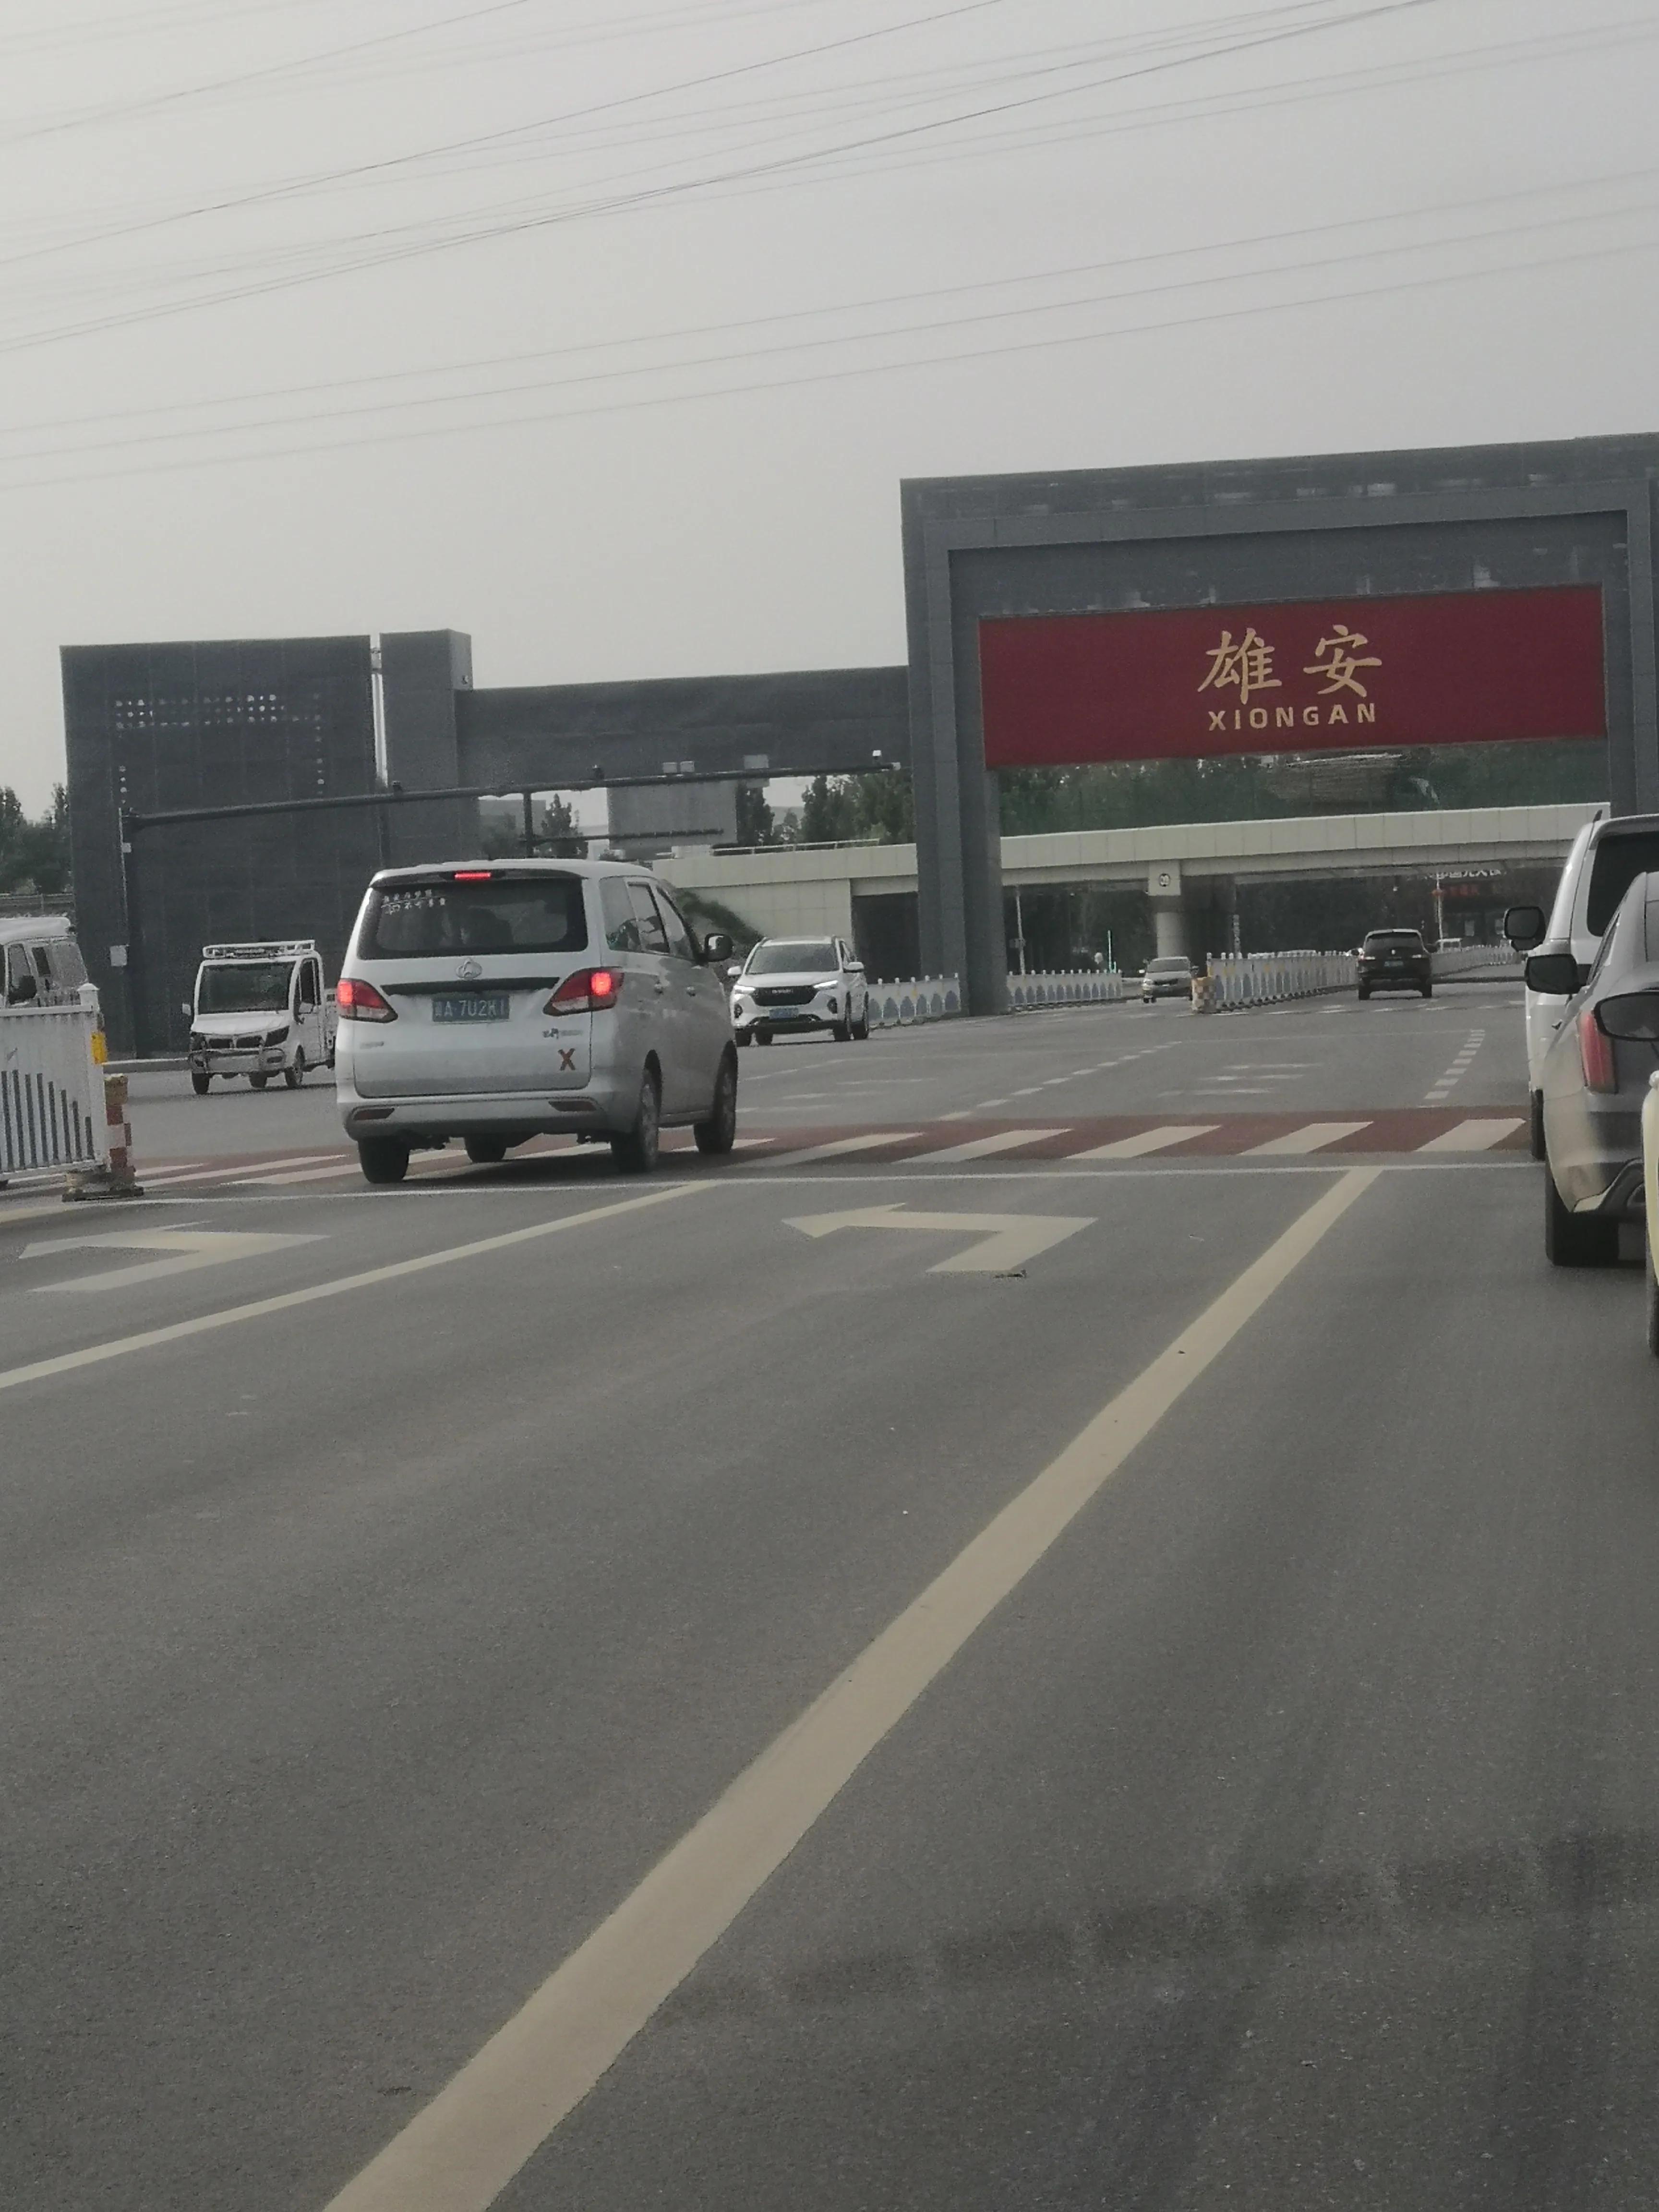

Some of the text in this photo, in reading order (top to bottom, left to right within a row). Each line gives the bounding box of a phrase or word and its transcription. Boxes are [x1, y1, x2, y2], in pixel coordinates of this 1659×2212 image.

[1198, 625, 1382, 704] 雄安
[1208, 703, 1375, 731] XIONGAN
[557, 1048, 576, 1071] X
